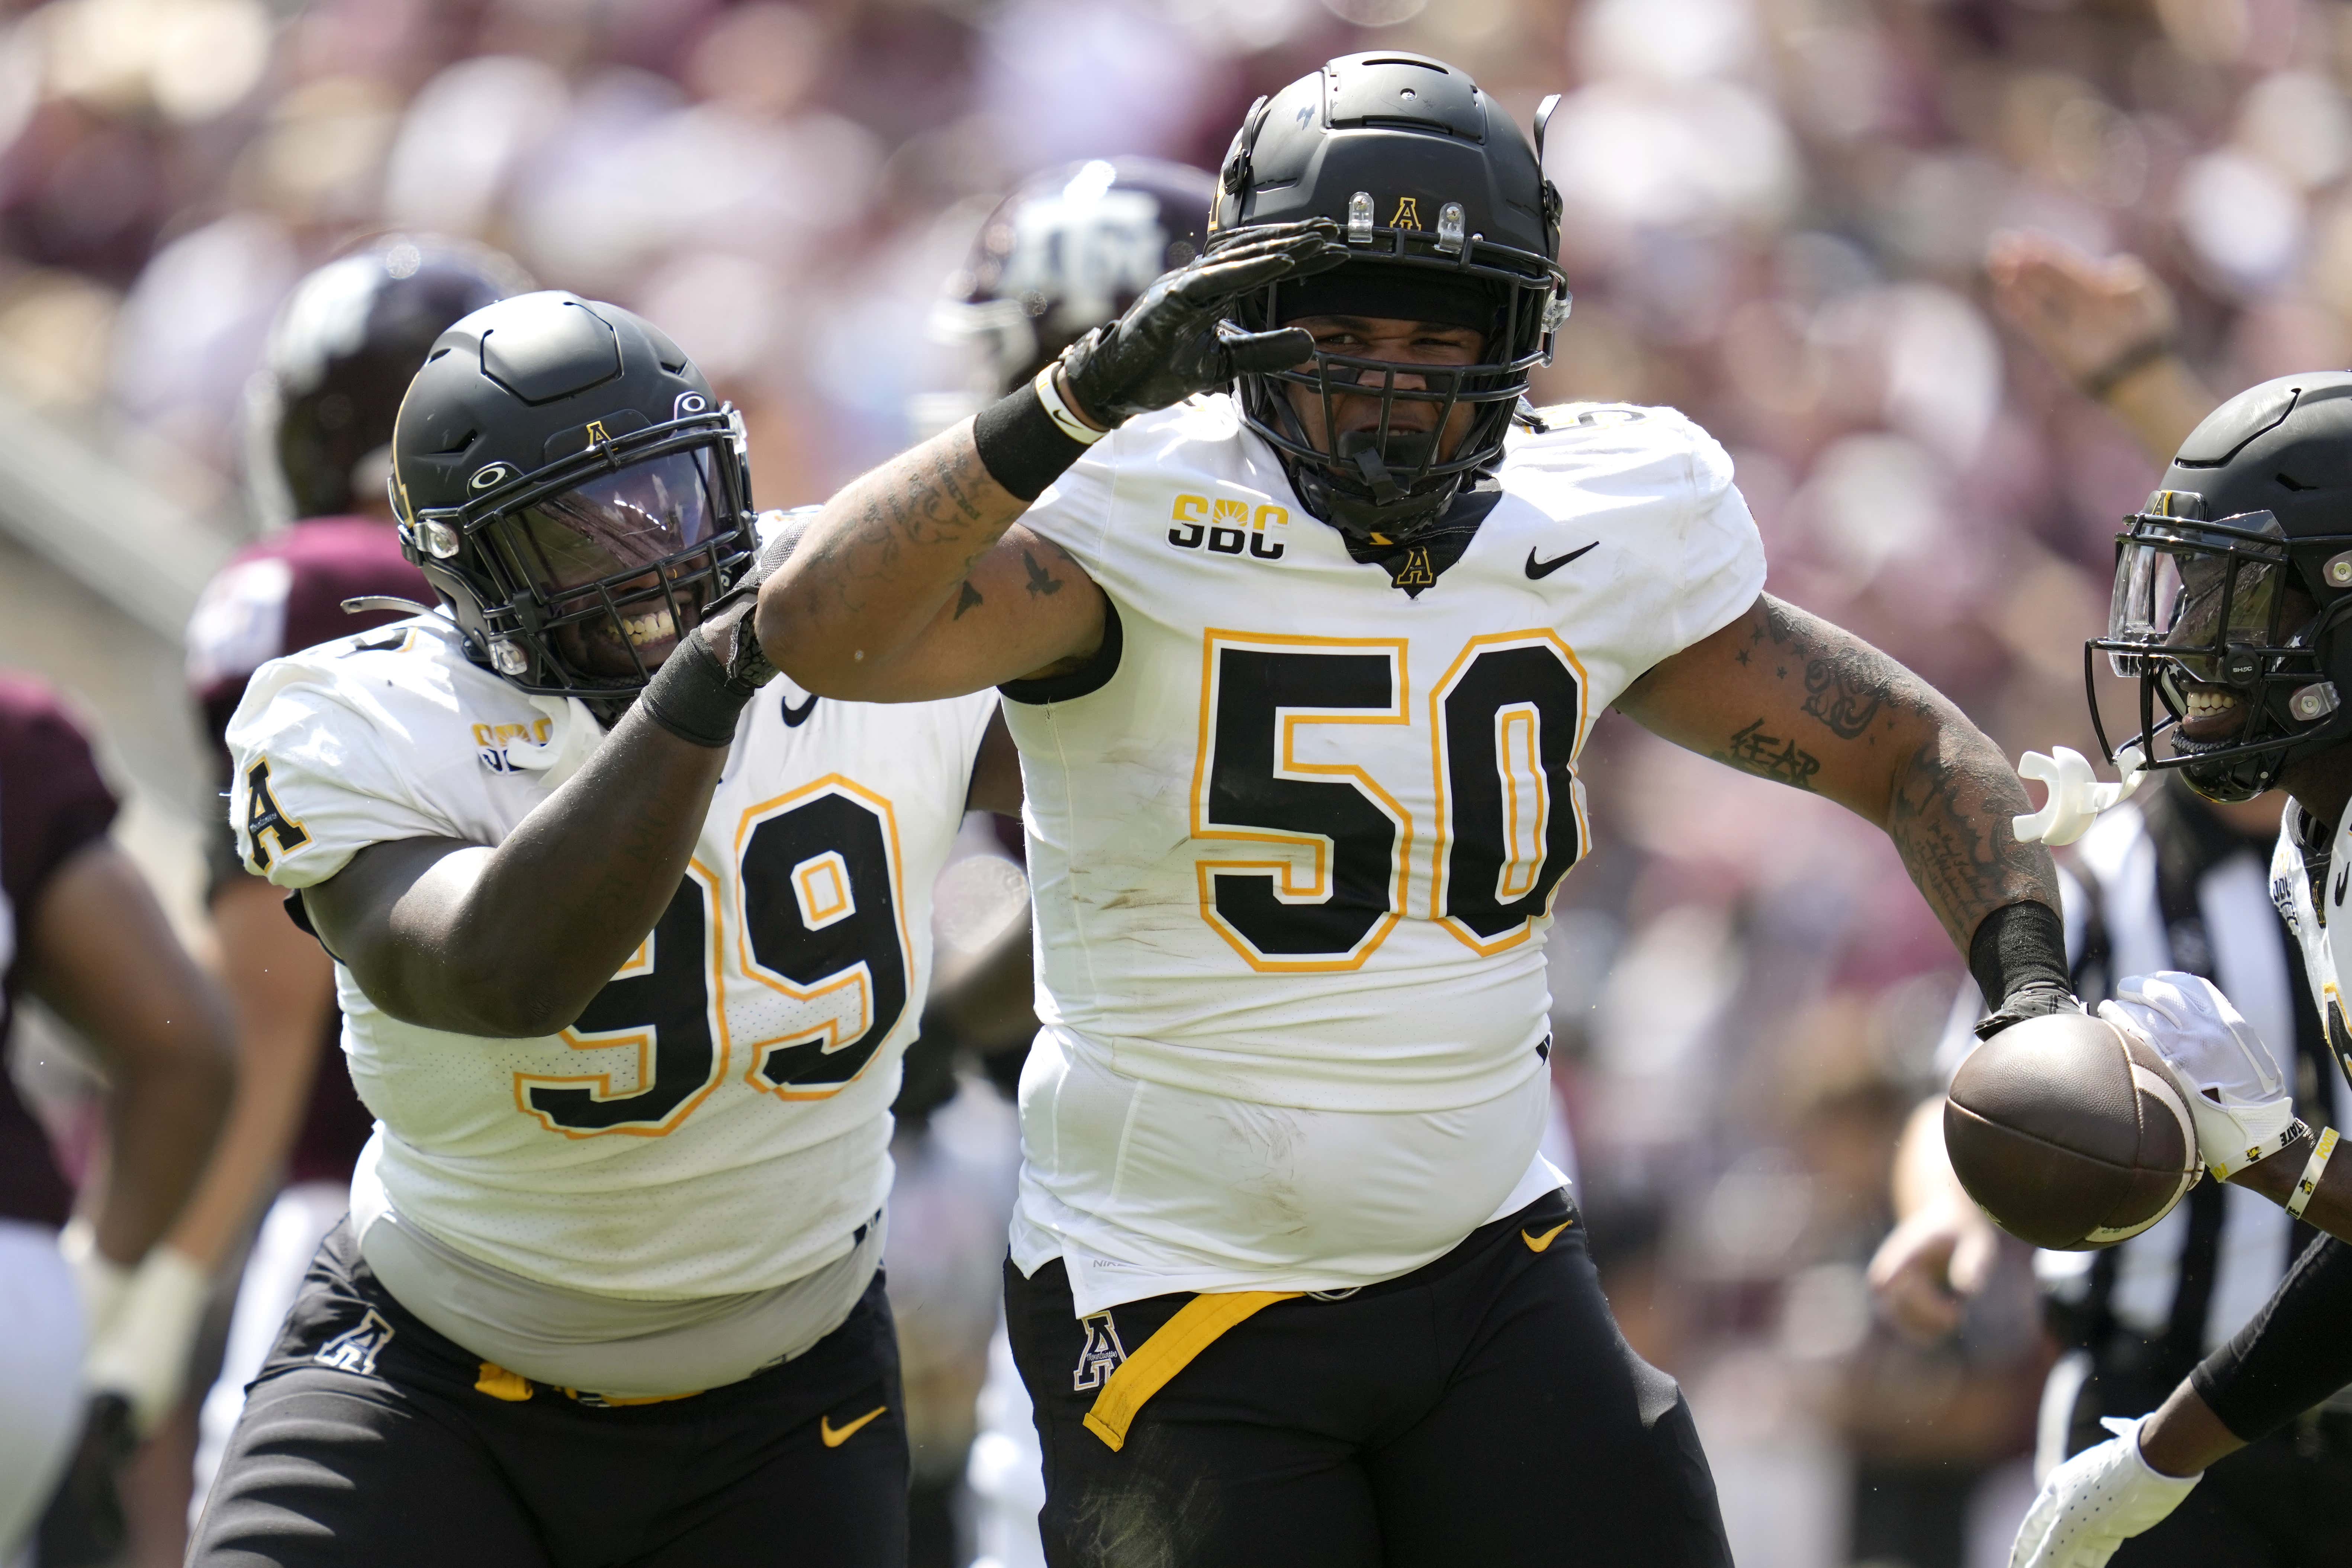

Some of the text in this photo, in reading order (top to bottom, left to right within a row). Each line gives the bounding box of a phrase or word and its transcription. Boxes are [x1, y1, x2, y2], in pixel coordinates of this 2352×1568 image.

[1389, 197, 1422, 231] A
[1168, 494, 1289, 559] SBC
[1397, 545, 1433, 585] A
[246, 756, 313, 874] A
[1190, 627, 1590, 972] 50
[514, 772, 914, 1139] 99
[314, 1308, 395, 1375] A
[1074, 1310, 1127, 1391] A
